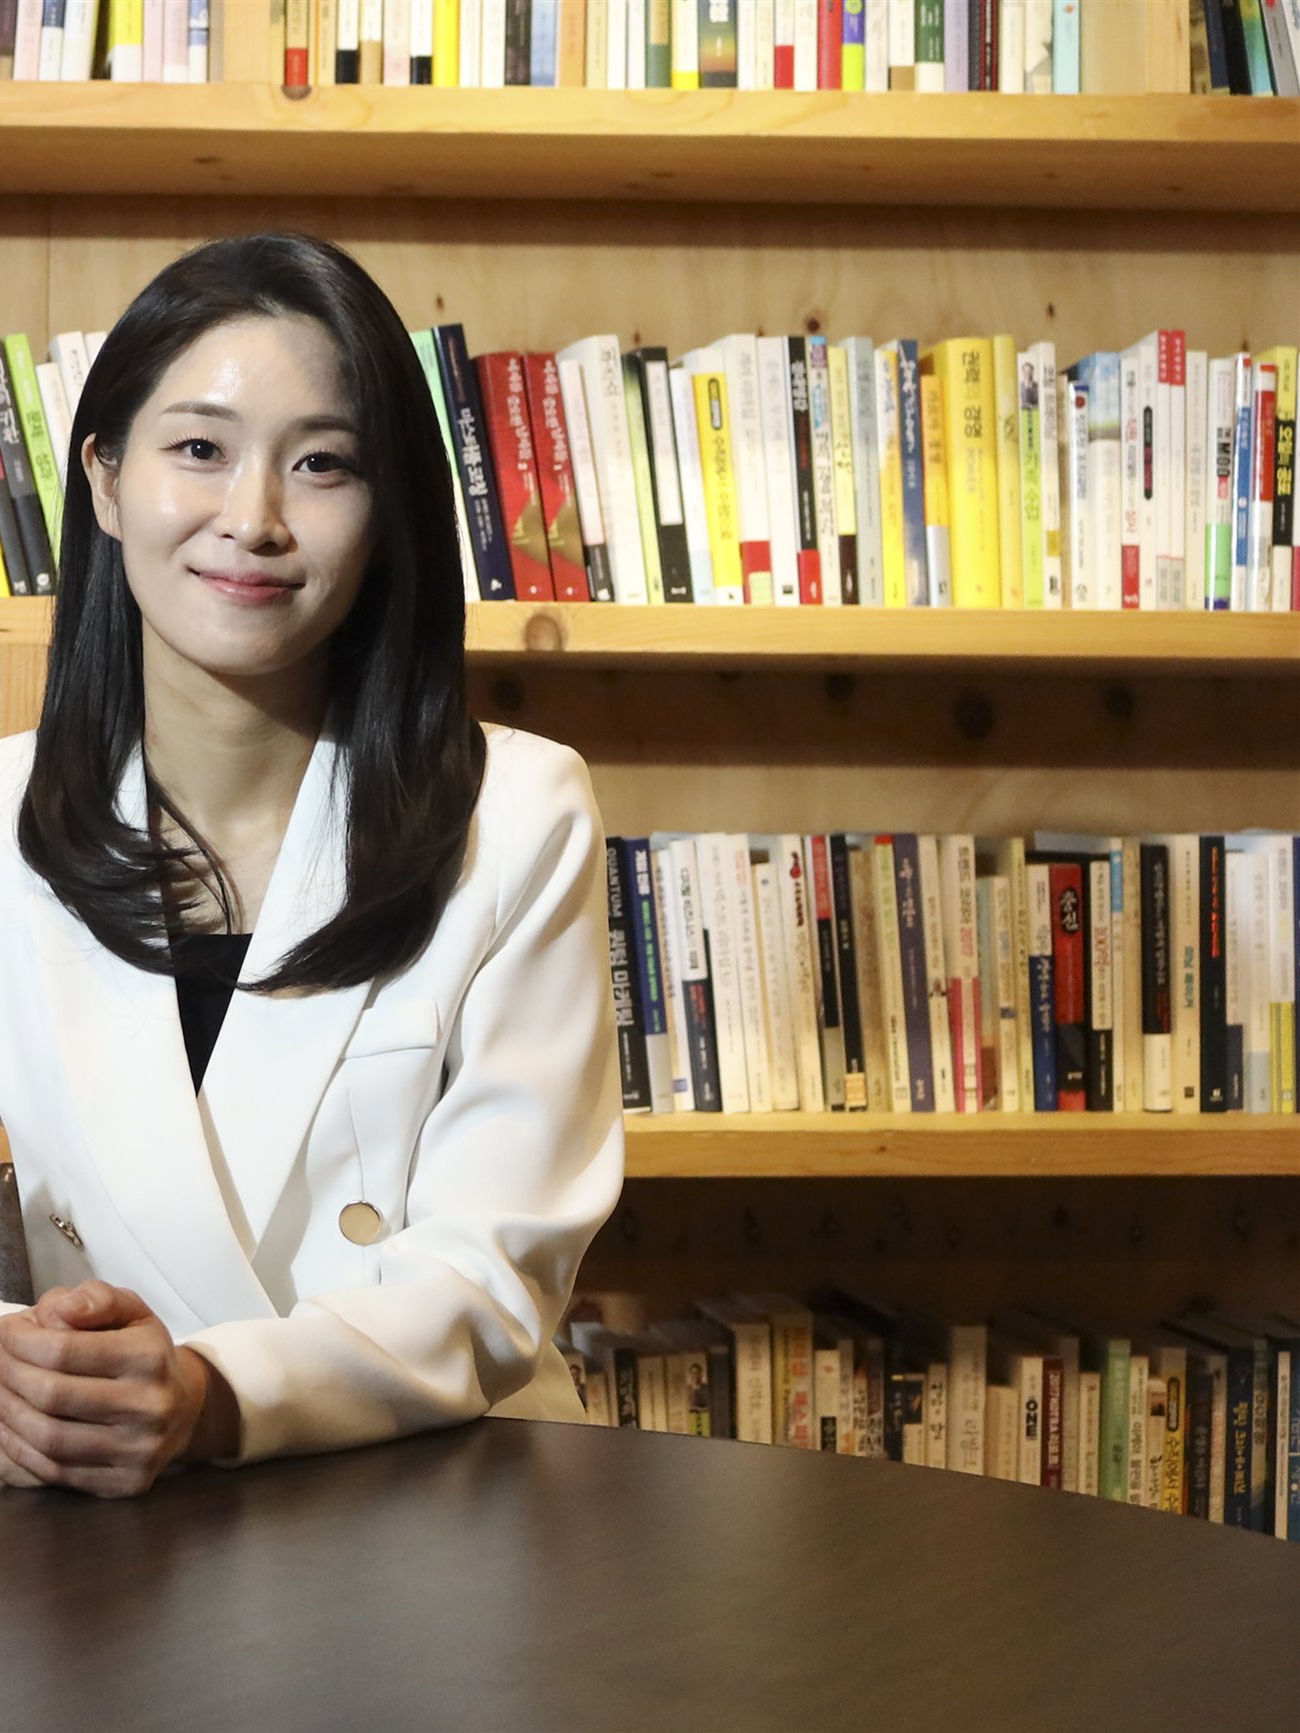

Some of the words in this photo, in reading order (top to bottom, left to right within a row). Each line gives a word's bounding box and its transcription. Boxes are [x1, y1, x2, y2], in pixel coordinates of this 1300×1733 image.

[964, 405, 982, 438] 경영
[607, 847, 623, 917] QUANTUM
[612, 964, 635, 1026] 마케팅
[1165, 1495, 1179, 1512] 수
